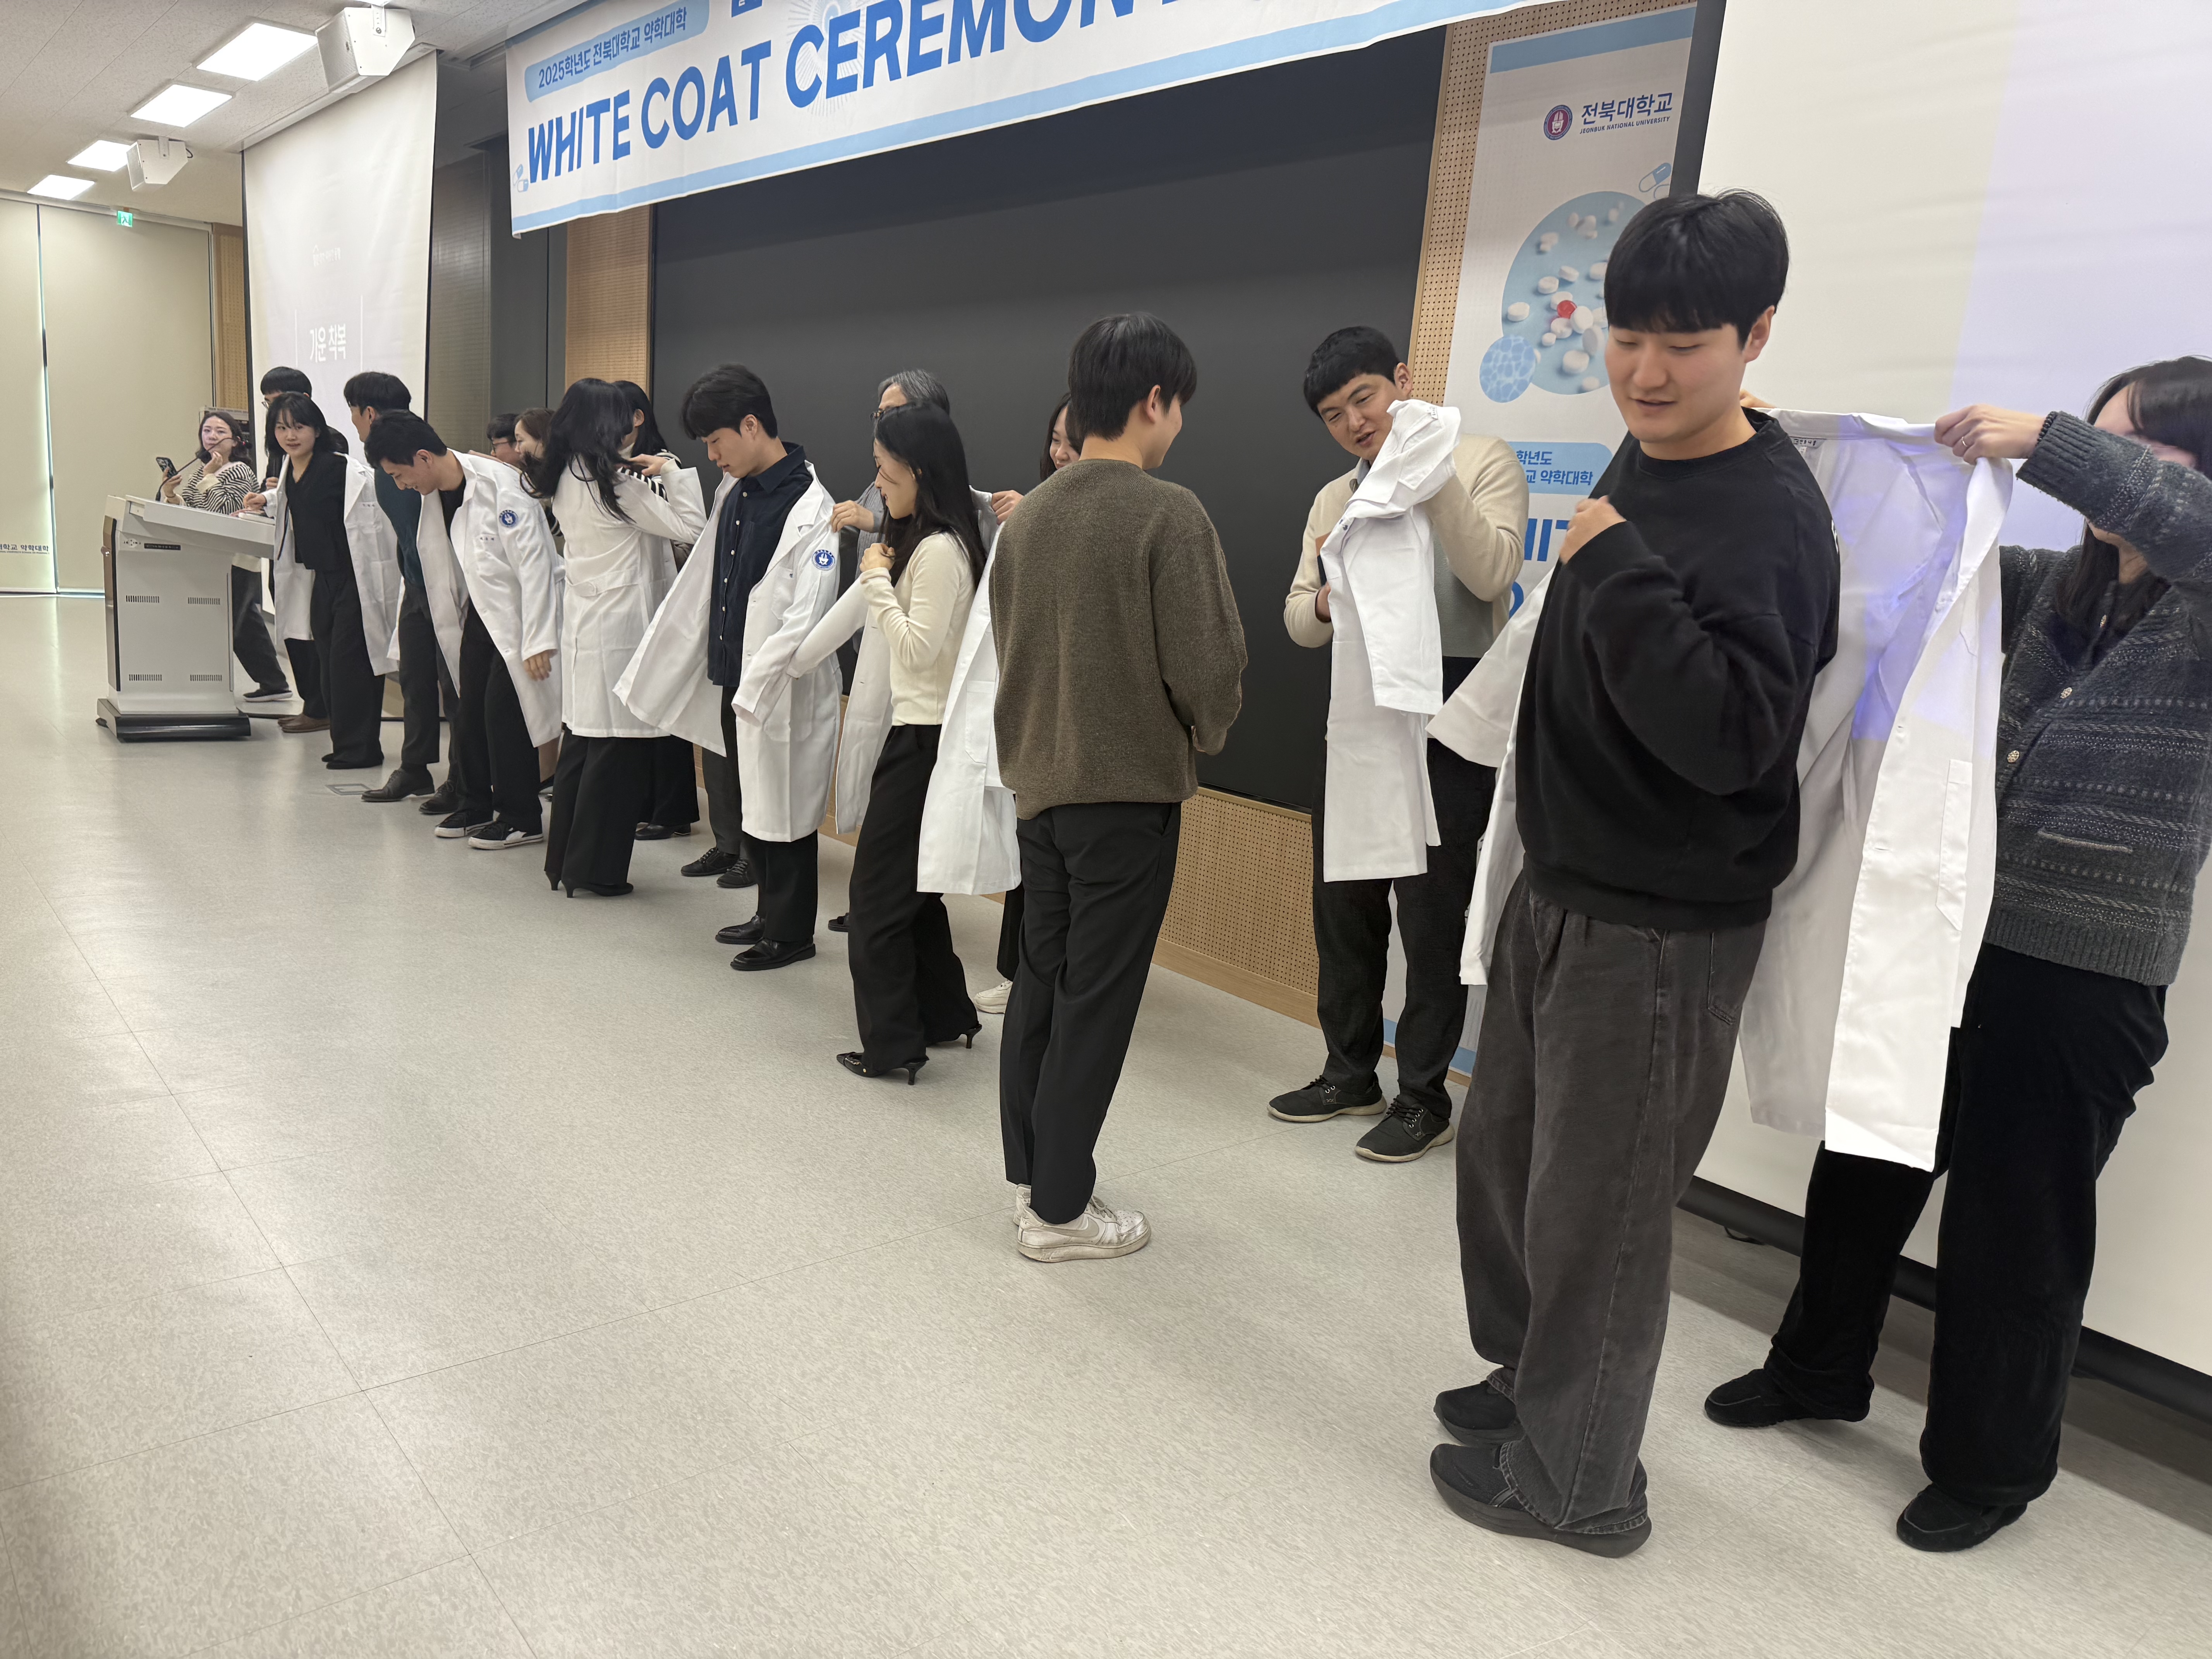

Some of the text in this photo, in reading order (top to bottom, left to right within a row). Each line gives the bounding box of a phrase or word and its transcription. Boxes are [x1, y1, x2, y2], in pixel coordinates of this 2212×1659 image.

[539, 48, 591, 89] 2025학년도
[593, 26, 641, 66] 전북대학교
[644, 6, 687, 44] 약학대학
[528, 0, 1178, 184] WHITE COAT CEREM
[1581, 92, 1673, 125] 전북대학교
[1580, 116, 1671, 134] JEONBUK NATIONAL UNIVERSITY
[310, 323, 346, 363] 가운 착복
[1540, 470, 1593, 485] 약학대학
